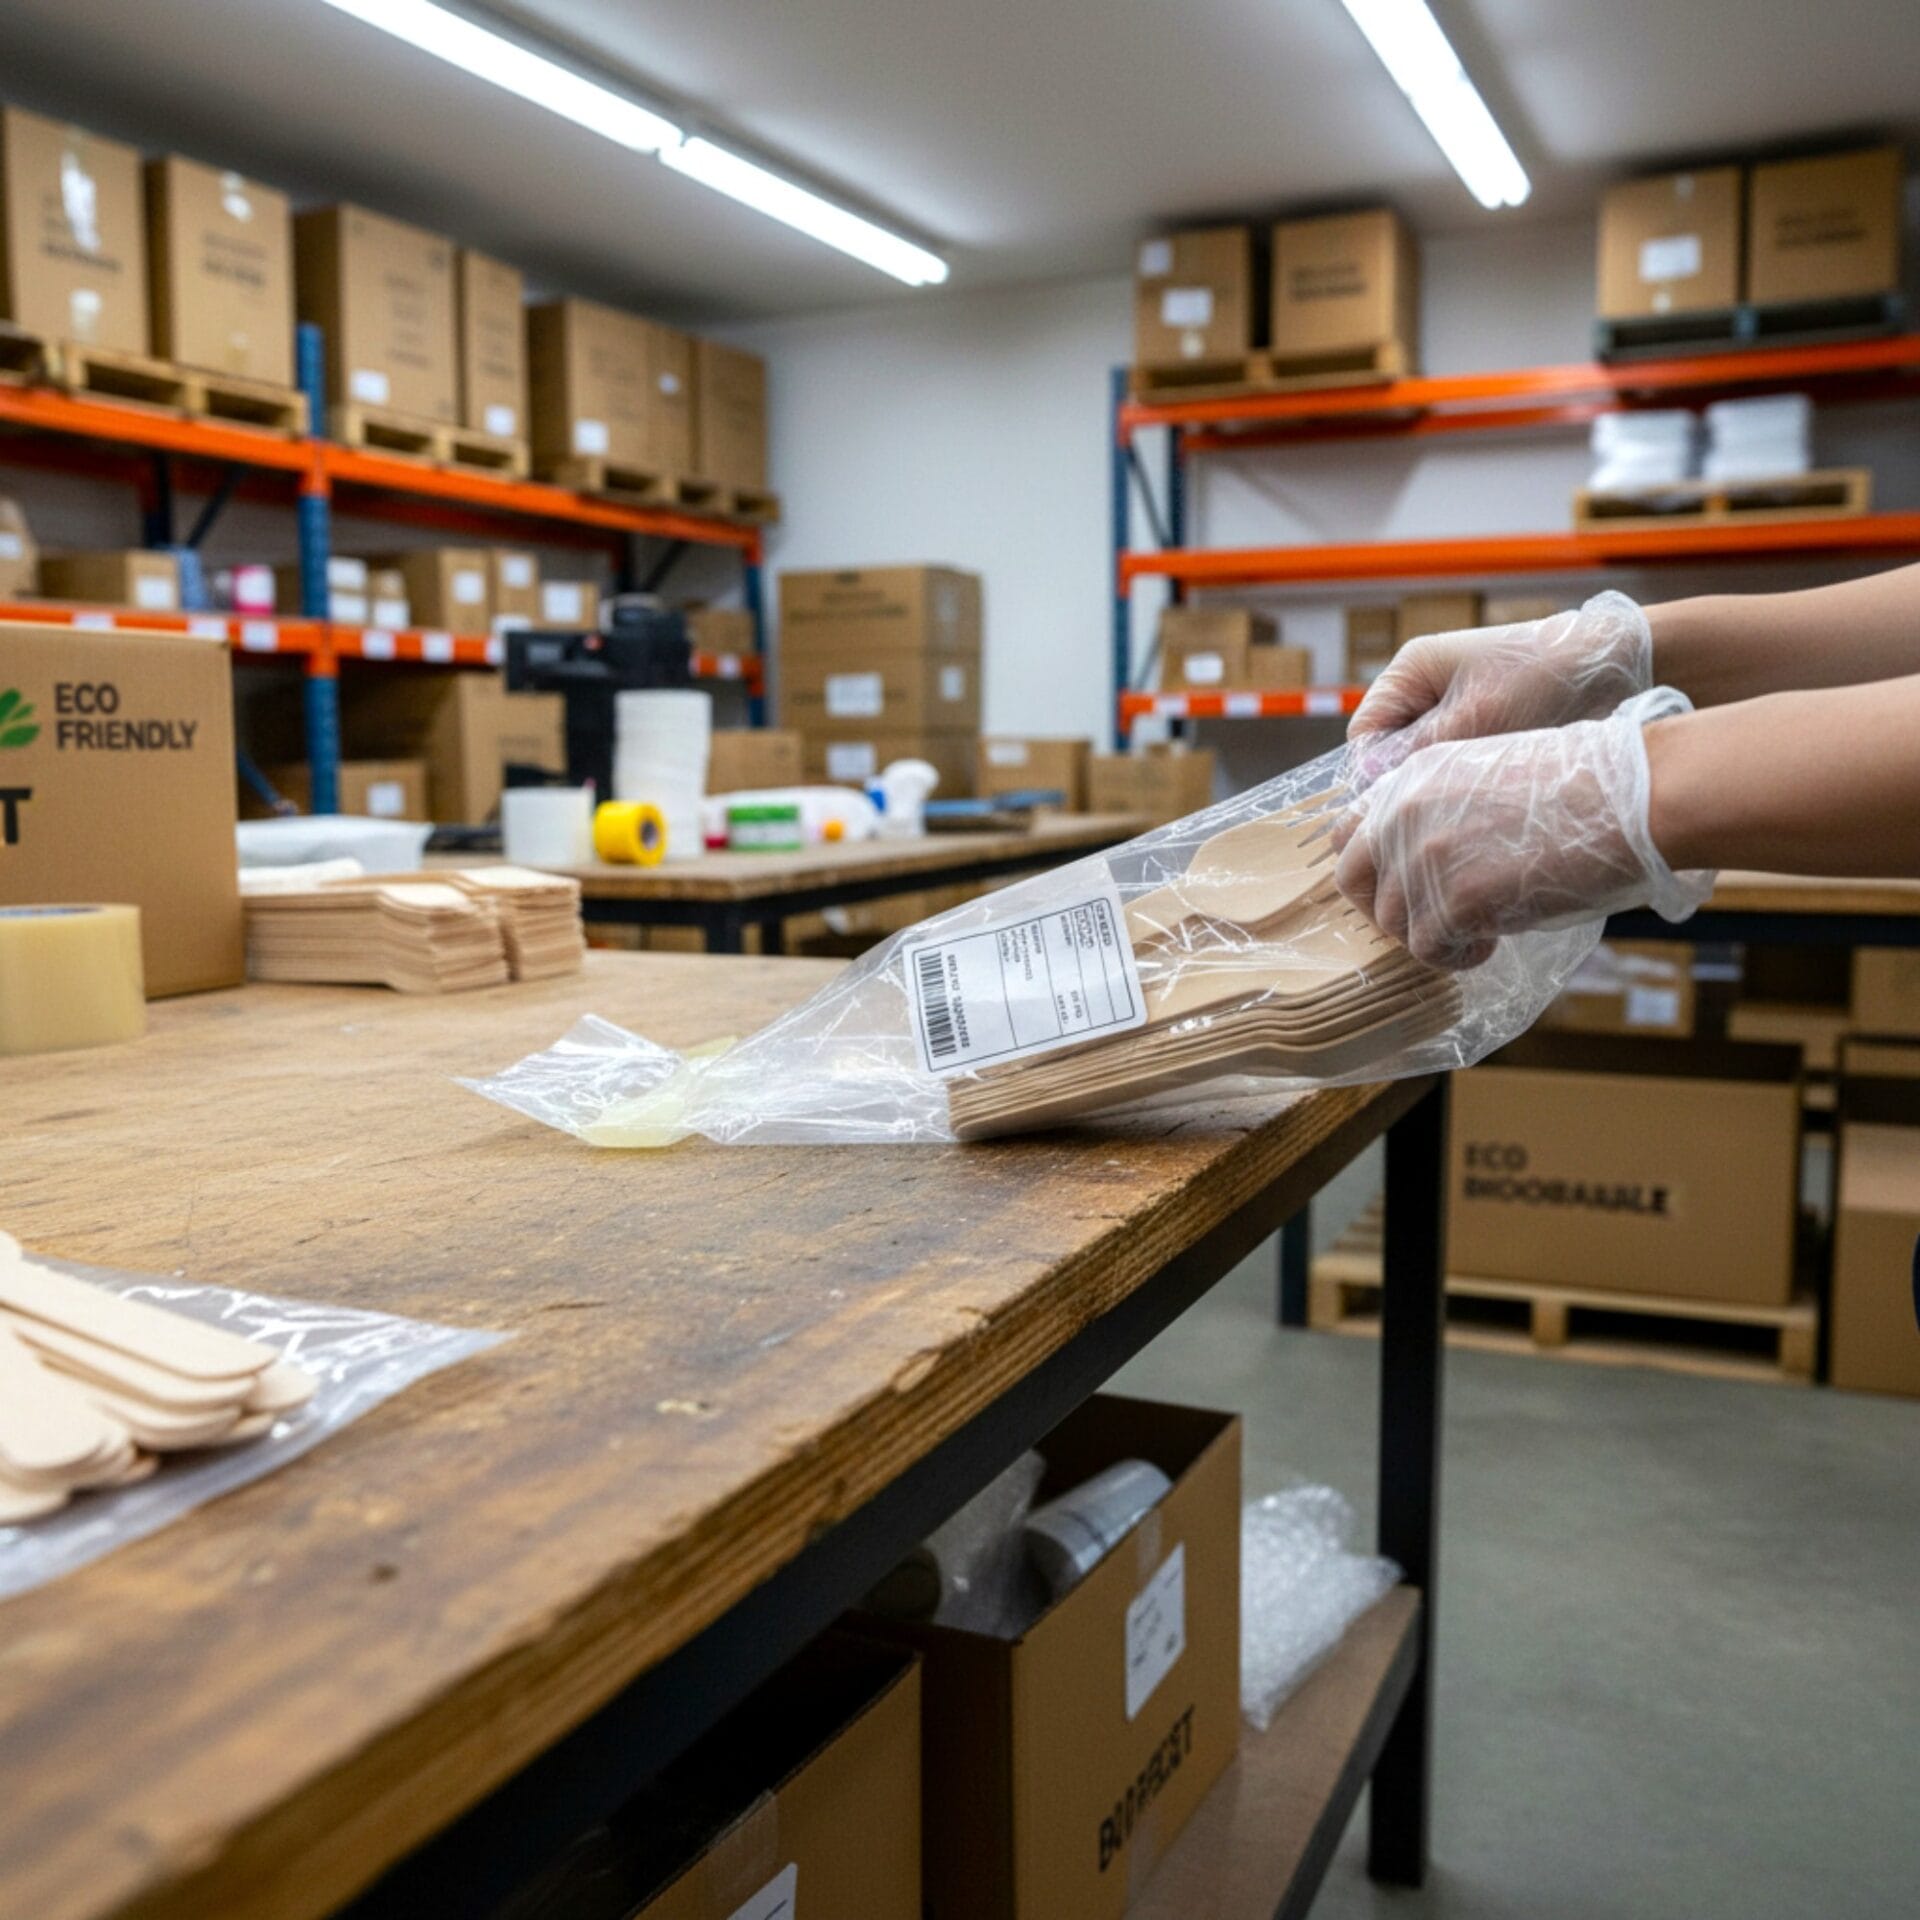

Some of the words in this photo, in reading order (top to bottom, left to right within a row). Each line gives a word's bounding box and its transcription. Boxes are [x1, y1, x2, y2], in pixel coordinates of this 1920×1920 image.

[55, 682, 119, 714] ECO
[56, 719, 197, 750] FRIENDLY
[1464, 1142, 1529, 1170] ECO
